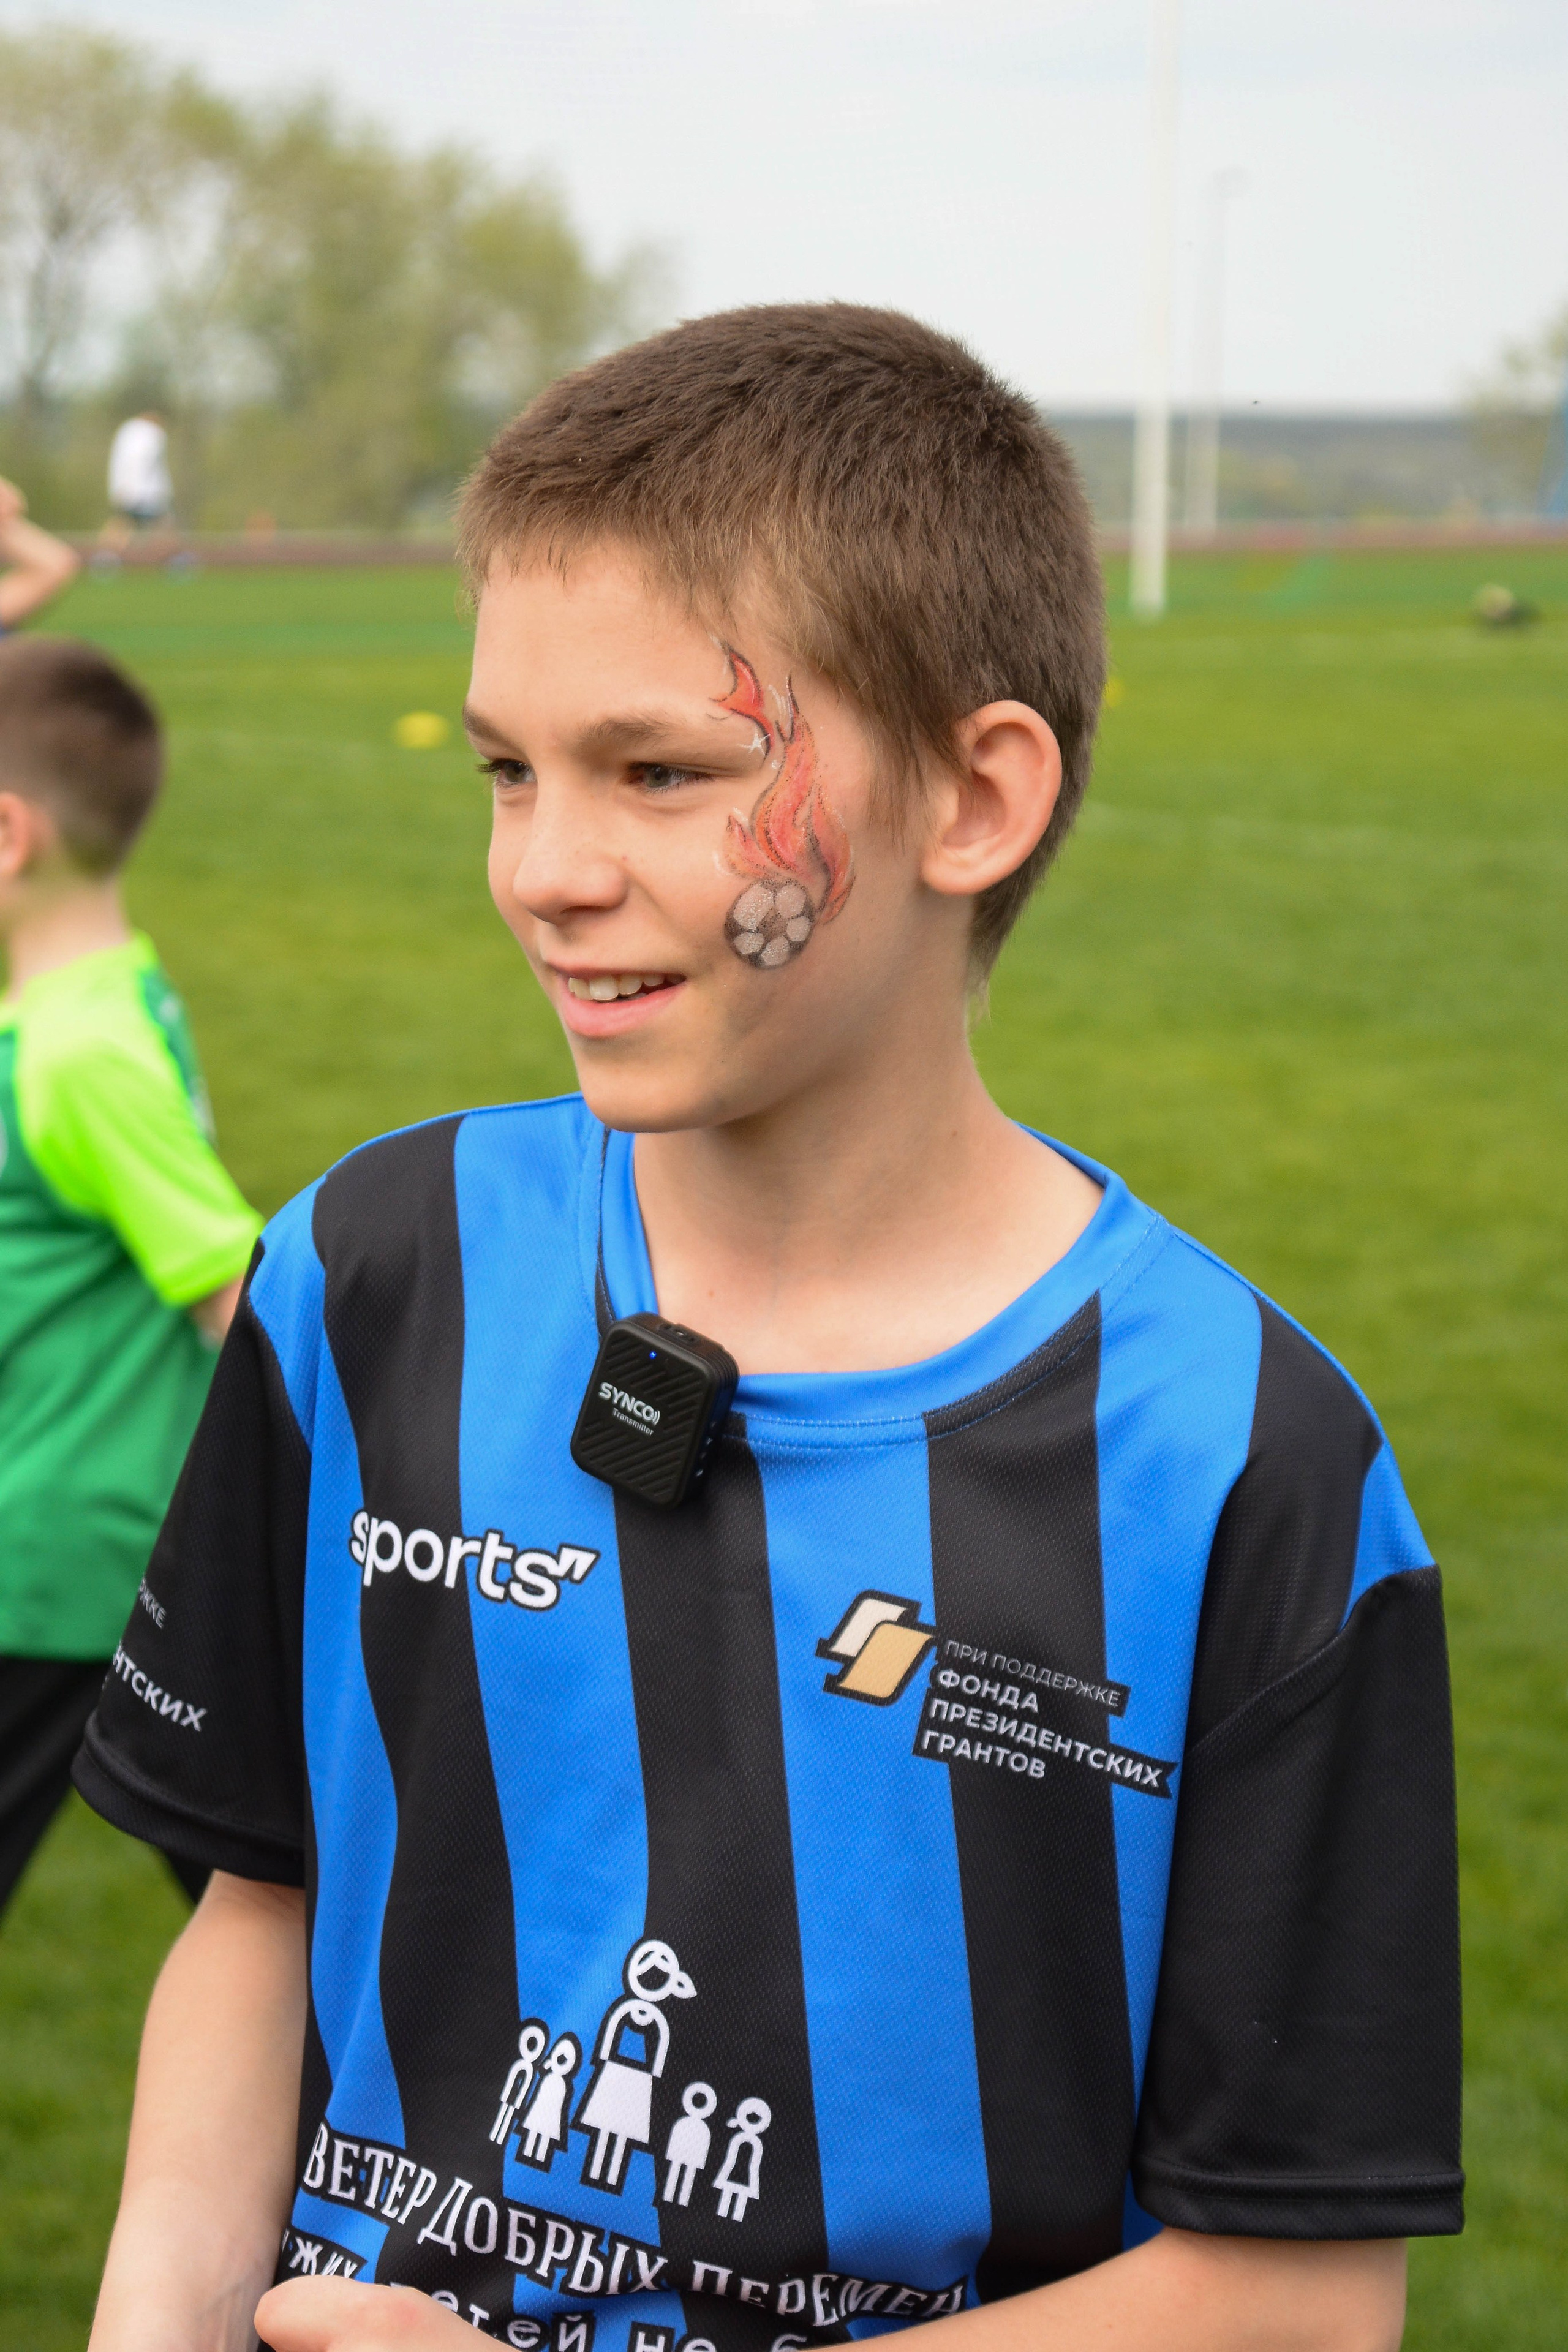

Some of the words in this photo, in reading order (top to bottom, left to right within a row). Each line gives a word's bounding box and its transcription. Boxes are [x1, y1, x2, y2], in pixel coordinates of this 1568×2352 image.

[598, 1382, 655, 1422] SYNCO
[612, 1408, 654, 1436] Transmitter
[937, 1668, 1039, 1713] ФОНДА
[944, 1640, 986, 1665] ПРИ
[990, 1653, 1121, 1708] ПОДДЕРЖКЕ
[921, 1729, 1046, 1779] ГРАНТОВ
[929, 1698, 1163, 1788] ПРЕЗИДЕНТСКИХ
[303, 2122, 437, 2225] ВЕТЕР
[417, 2177, 668, 2296] ДОБРЫХ
[692, 2259, 963, 2327] ПЕРЕМЕН
